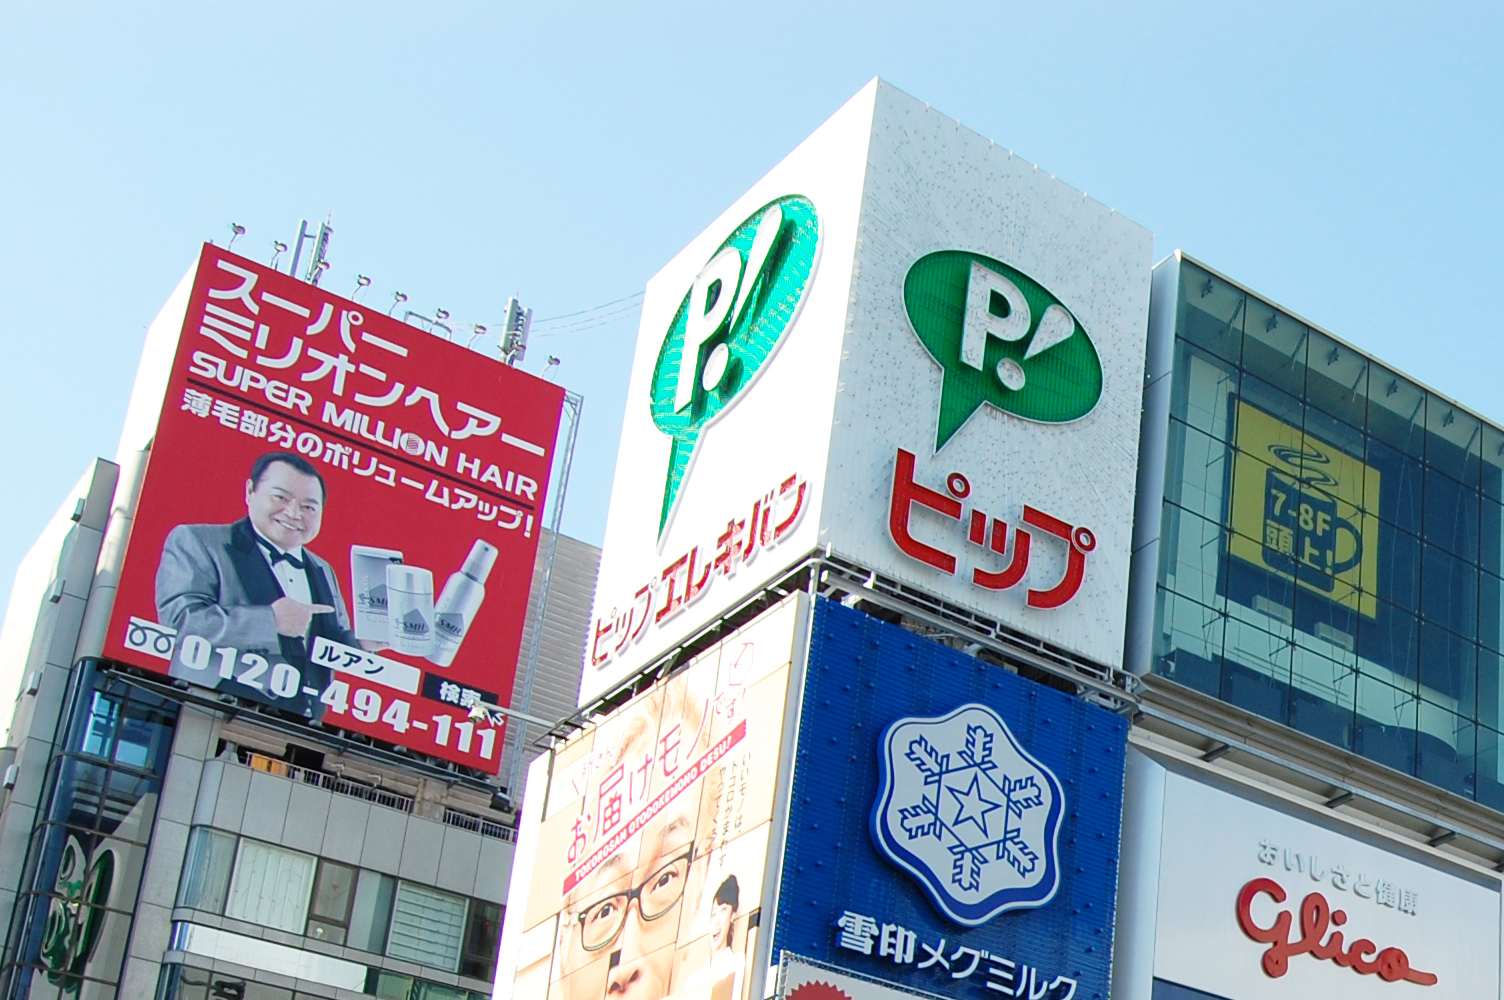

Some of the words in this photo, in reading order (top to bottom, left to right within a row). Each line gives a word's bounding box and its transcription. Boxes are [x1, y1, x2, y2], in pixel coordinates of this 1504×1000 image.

[207, 259, 409, 358] スーパー
[188, 352, 314, 416] SUPER
[321, 402, 451, 466] MILLION
[455, 451, 541, 502] HAIR
[199, 302, 546, 458] ミリオンヘアー
[180, 387, 534, 538] 薄毛部分のボリュームアップ!
[1269, 487, 1332, 538] 7-8F
[590, 472, 810, 668] ピップエレキバン
[887, 446, 1098, 611] ピップ
[1265, 519, 1335, 576] 頭上!
[180, 635, 498, 760] 0120-494-111
[317, 643, 385, 675] ルアン
[574, 828, 628, 882] TOKOROSAN
[628, 769, 699, 834] OTODOKEMONO
[700, 735, 732, 769] DESU!
[1236, 877, 1439, 987] Glico
[1257, 838, 1420, 917] おいしさと健康
